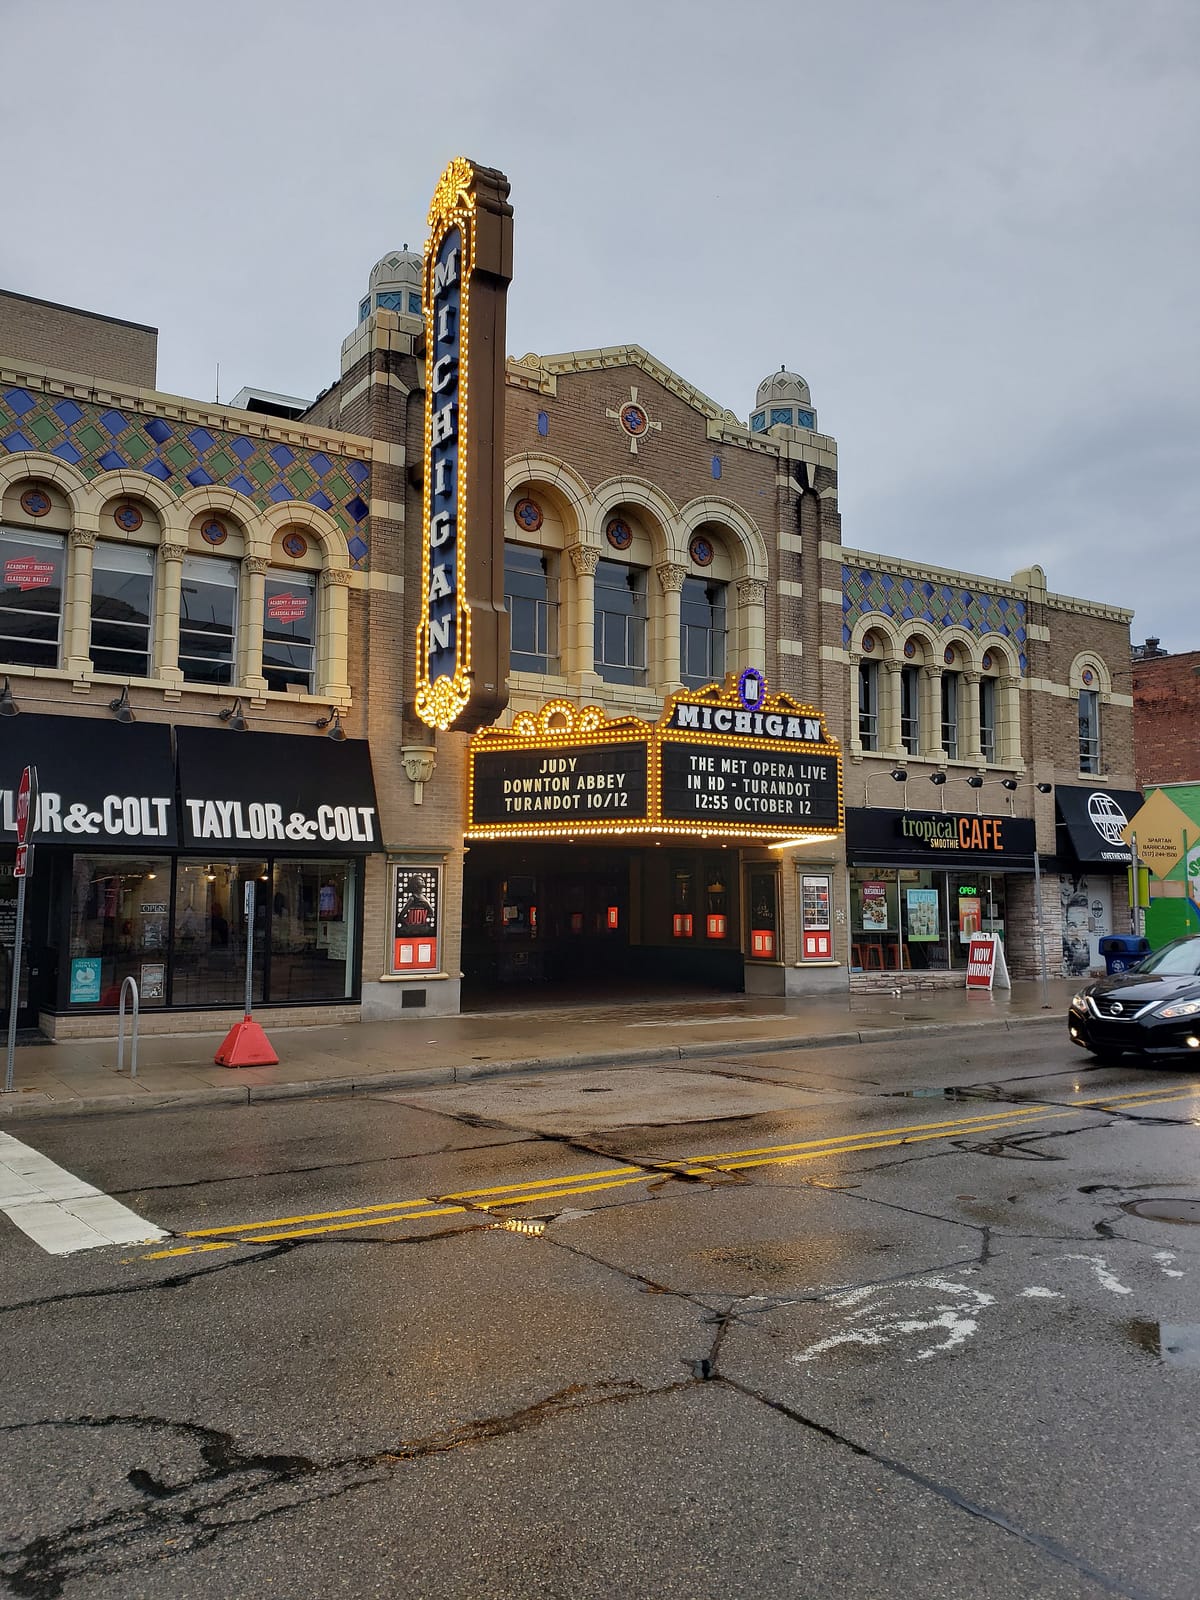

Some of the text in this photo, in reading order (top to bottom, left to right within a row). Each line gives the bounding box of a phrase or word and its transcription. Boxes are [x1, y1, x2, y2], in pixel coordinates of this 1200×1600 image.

[428, 247, 457, 655] MICHIGAN
[677, 704, 820, 740] MICHIGAN
[539, 758, 577, 774] JUDY
[690, 756, 827, 781] THE MET OPERA LIVE
[503, 773, 625, 794] DOWNTON ABBEY
[687, 774, 701, 790] IN
[708, 776, 725, 791] HD
[743, 778, 811, 797] TURANDOT
[505, 792, 628, 812] TURANDOT 10/12
[695, 793, 811, 815] 12:55 OCTOBER 12
[1091, 797, 1113, 815] THE
[186, 799, 375, 842] TAYLOR&COLT
[902, 815, 1004, 850] tropical CAFE
[930, 838, 959, 849] SMOOTHIE
[959, 886, 977, 895] OPEN
[407, 908, 428, 925] JUDY
[973, 947, 991, 962] NOW
[967, 962, 992, 977] HIRING
